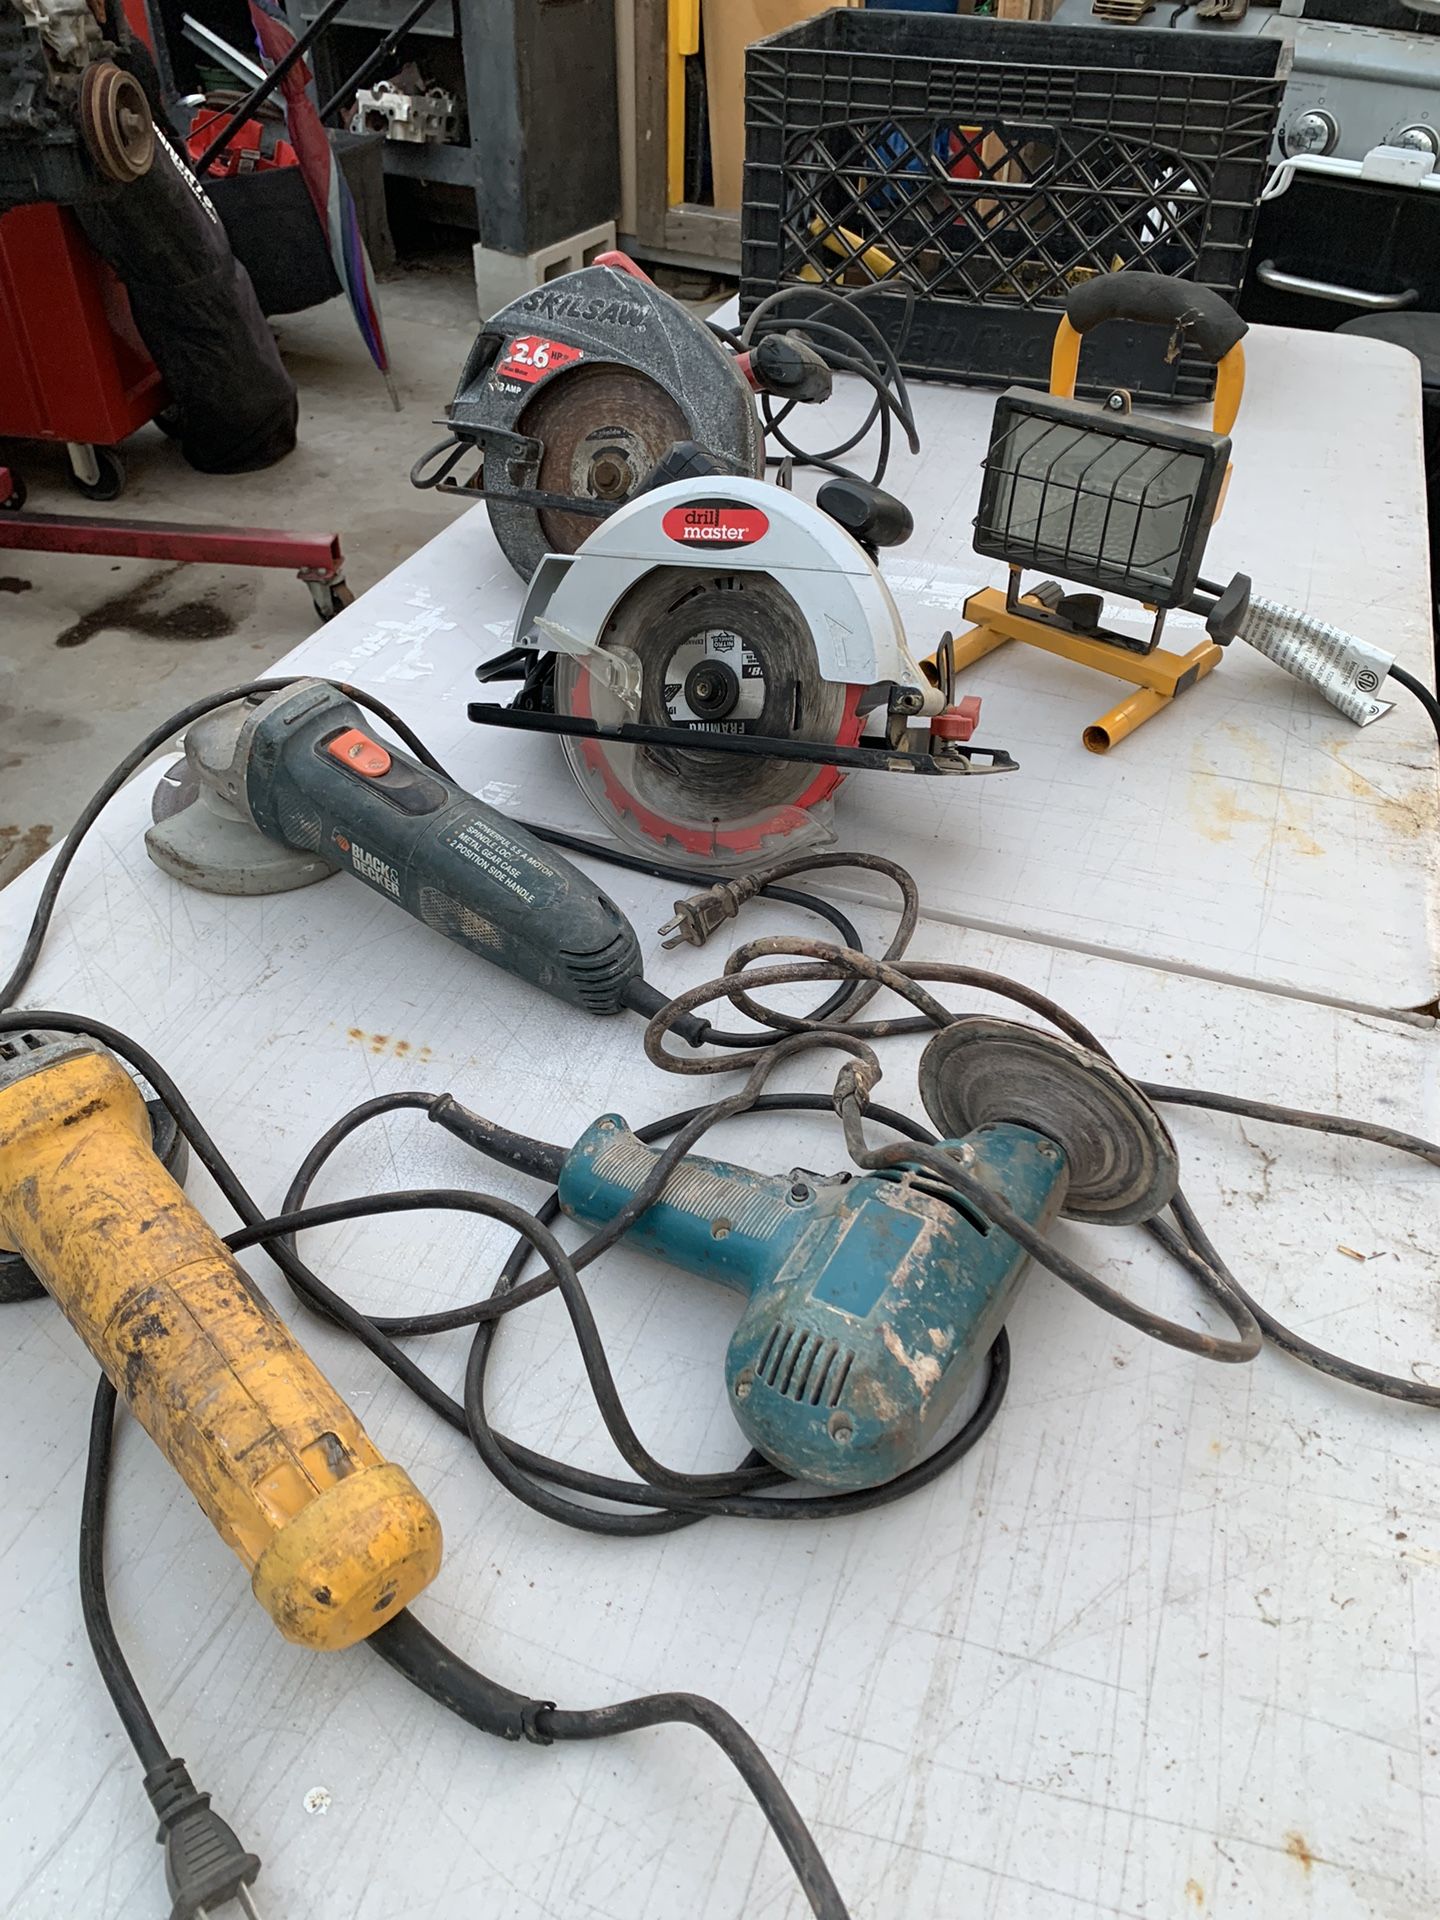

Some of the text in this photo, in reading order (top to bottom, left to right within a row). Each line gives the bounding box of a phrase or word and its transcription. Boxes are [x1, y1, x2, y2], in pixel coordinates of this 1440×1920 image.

[522, 290, 648, 327] SKILSAW
[513, 342, 550, 369] 2.6
[505, 383, 522, 394] AMP
[683, 524, 746, 540] master
[685, 509, 720, 527] drill
[466, 825, 498, 849] SPINDLE
[473, 820, 554, 878] POWERFUL 5.5 A MOTOR
[449, 839, 536, 904] 2 POSITION SIDE HANDLE
[458, 832, 522, 879] METAL GEAR CASE
[352, 856, 401, 897] DECKER
